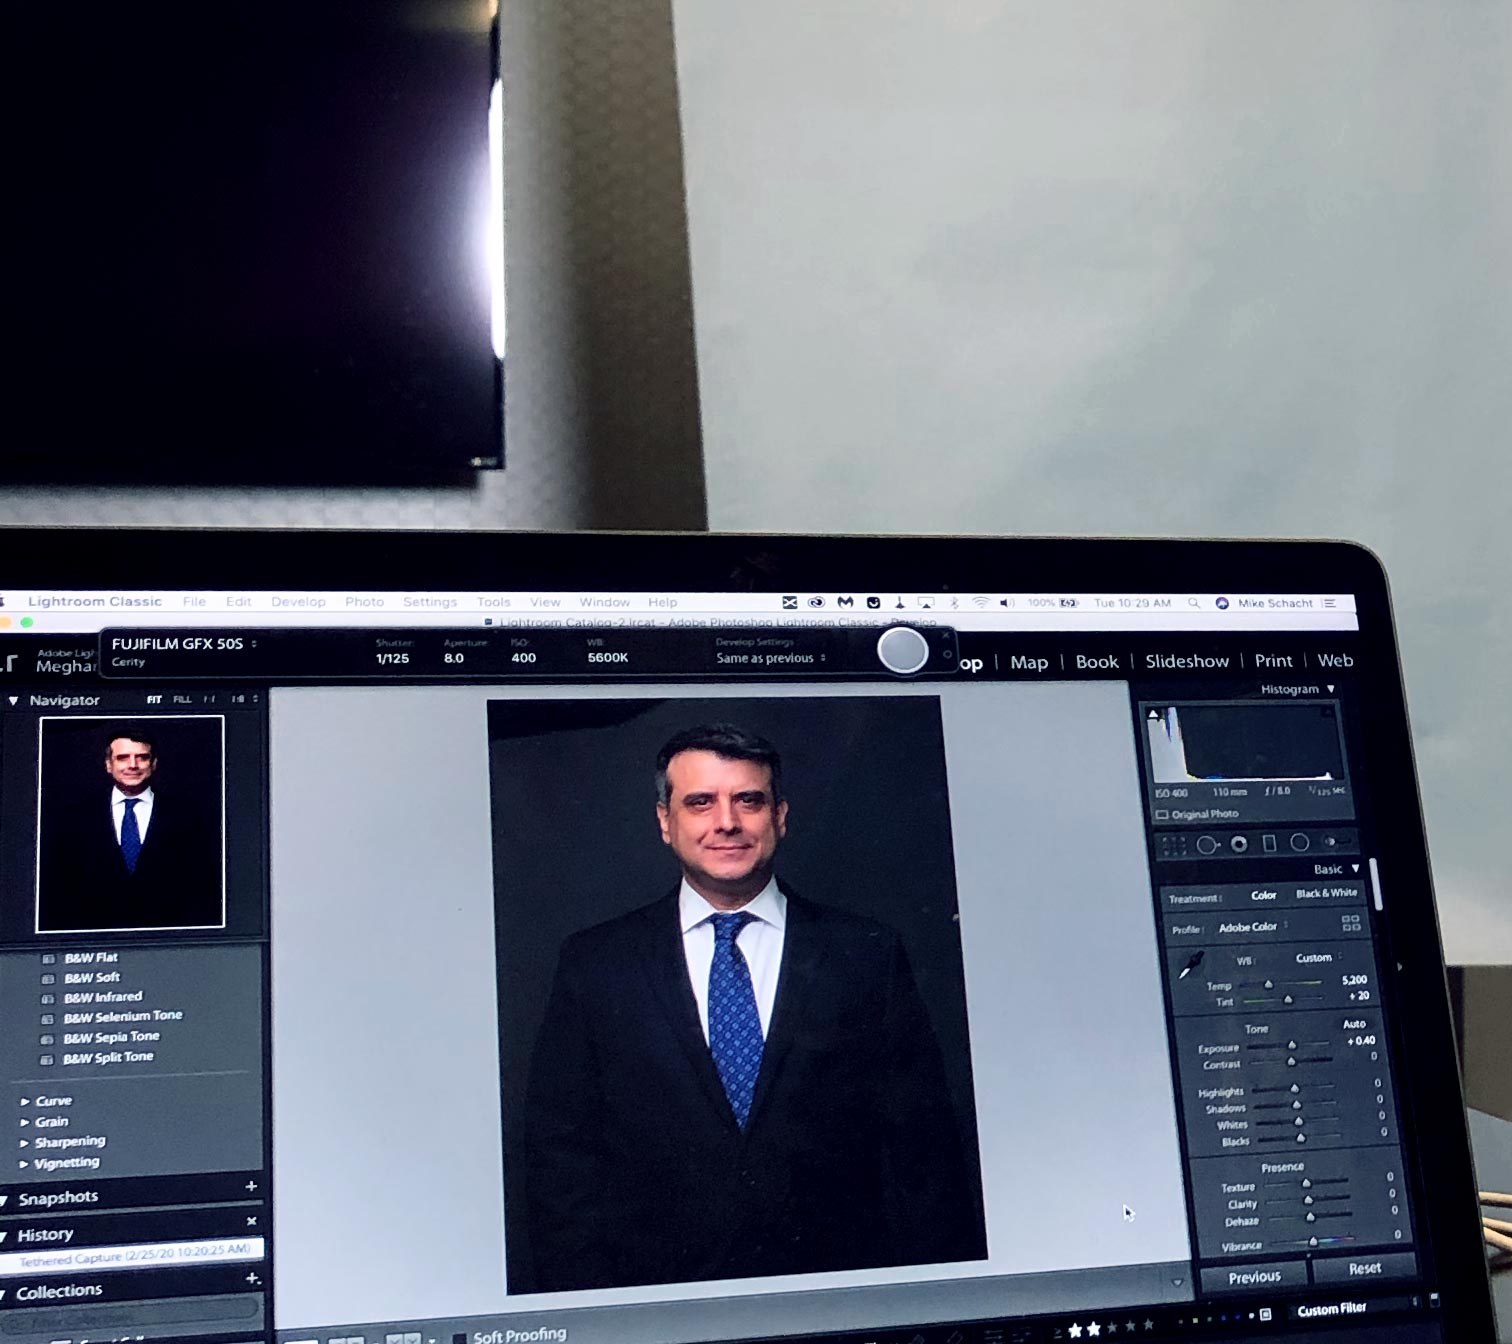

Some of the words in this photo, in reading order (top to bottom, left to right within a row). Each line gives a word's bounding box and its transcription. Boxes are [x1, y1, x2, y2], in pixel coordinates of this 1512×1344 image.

[28, 596, 105, 609] Lightroom
[109, 596, 162, 607] Classic
[183, 596, 207, 607] File
[226, 596, 252, 607] Edit
[271, 596, 326, 610] Develop
[345, 596, 385, 608] Photo
[403, 596, 458, 610] Settings
[477, 596, 511, 608] Tools
[530, 596, 561, 608] View
[580, 596, 631, 608] Window
[649, 597, 678, 610] Help
[1028, 598, 1055, 608] 100%
[1094, 598, 1115, 608] Tue
[1118, 598, 1151, 608] 10:29
[1153, 598, 1172, 608] AM
[1238, 598, 1265, 608] Mike
[1267, 598, 1314, 608] Schacht
[838, 618, 879, 627] Classic
[112, 638, 179, 650] FUJIFILM
[183, 638, 213, 650] GFX
[112, 657, 146, 668] Cerity
[376, 653, 410, 665] 1/125
[444, 653, 464, 663] 8.0
[511, 653, 536, 664] 400
[587, 652, 629, 663] 5600K
[716, 653, 748, 664] Same
[751, 655, 763, 664] as
[765, 652, 814, 666] previous
[1011, 656, 1049, 671] Map
[1076, 655, 1119, 670] Book
[1146, 654, 1229, 669] Slideshow
[1255, 654, 1293, 668] Print
[1317, 653, 1354, 668] Web
[1261, 684, 1319, 696] Histogram
[30, 695, 100, 709] Navigator
[1172, 809, 1209, 820] Original
[1210, 809, 1239, 818] Photo
[1314, 864, 1343, 874] Basic
[1251, 890, 1277, 901] Color
[1296, 888, 1320, 898] Black
[1330, 887, 1358, 897] White
[1219, 923, 1250, 933] Adobe
[1251, 922, 1277, 932] Color
[64, 952, 94, 964] B&W
[96, 952, 119, 963] Flat
[1296, 953, 1333, 963] Custom
[64, 973, 94, 984] B&W
[96, 972, 121, 983] Soft
[1207, 982, 1233, 992] Temp
[64, 993, 94, 1004] B&W
[96, 991, 143, 1003] Infrared
[1216, 997, 1234, 1007] Tint
[1357, 991, 1370, 1001] 20
[64, 1013, 94, 1024] B&W
[96, 1011, 151, 1024] Selenium
[153, 1010, 183, 1021] Tone
[1245, 1025, 1269, 1034] Tone
[1343, 1019, 1366, 1029] Auto
[64, 1033, 94, 1045] B&W
[95, 1032, 128, 1045] Sepia
[131, 1031, 161, 1042] Tone
[1198, 1044, 1240, 1055] Exposure
[63, 1054, 93, 1065] B&W
[95, 1052, 123, 1065] Split
[124, 1051, 154, 1062] Tone
[1203, 1060, 1241, 1070] Contrast
[1198, 1087, 1245, 1099] Highlights
[36, 1095, 73, 1107] Curve
[1206, 1103, 1246, 1114] Shadows
[35, 1116, 69, 1128] Grain
[1217, 1120, 1248, 1131] Whites
[35, 1135, 107, 1150] Sharpening
[1222, 1137, 1250, 1147] Blacks
[34, 1156, 101, 1171] Vignetting
[1261, 1162, 1305, 1174] Presence
[1221, 1183, 1256, 1193] Texture
[18, 1190, 99, 1208] Snapshots
[1228, 1199, 1258, 1211] Clarity
[1225, 1217, 1260, 1227] Dehaze
[18, 1228, 74, 1244] History
[1221, 1241, 1262, 1253] Vibrance
[21, 1254, 73, 1267] Tethered
[75, 1252, 123, 1266] Capture
[1229, 1270, 1282, 1285] Previous
[1349, 1262, 1382, 1276] Reset
[16, 1283, 103, 1301] Collections
[1298, 1306, 1339, 1319] Custom
[1341, 1302, 1368, 1315] Filter
